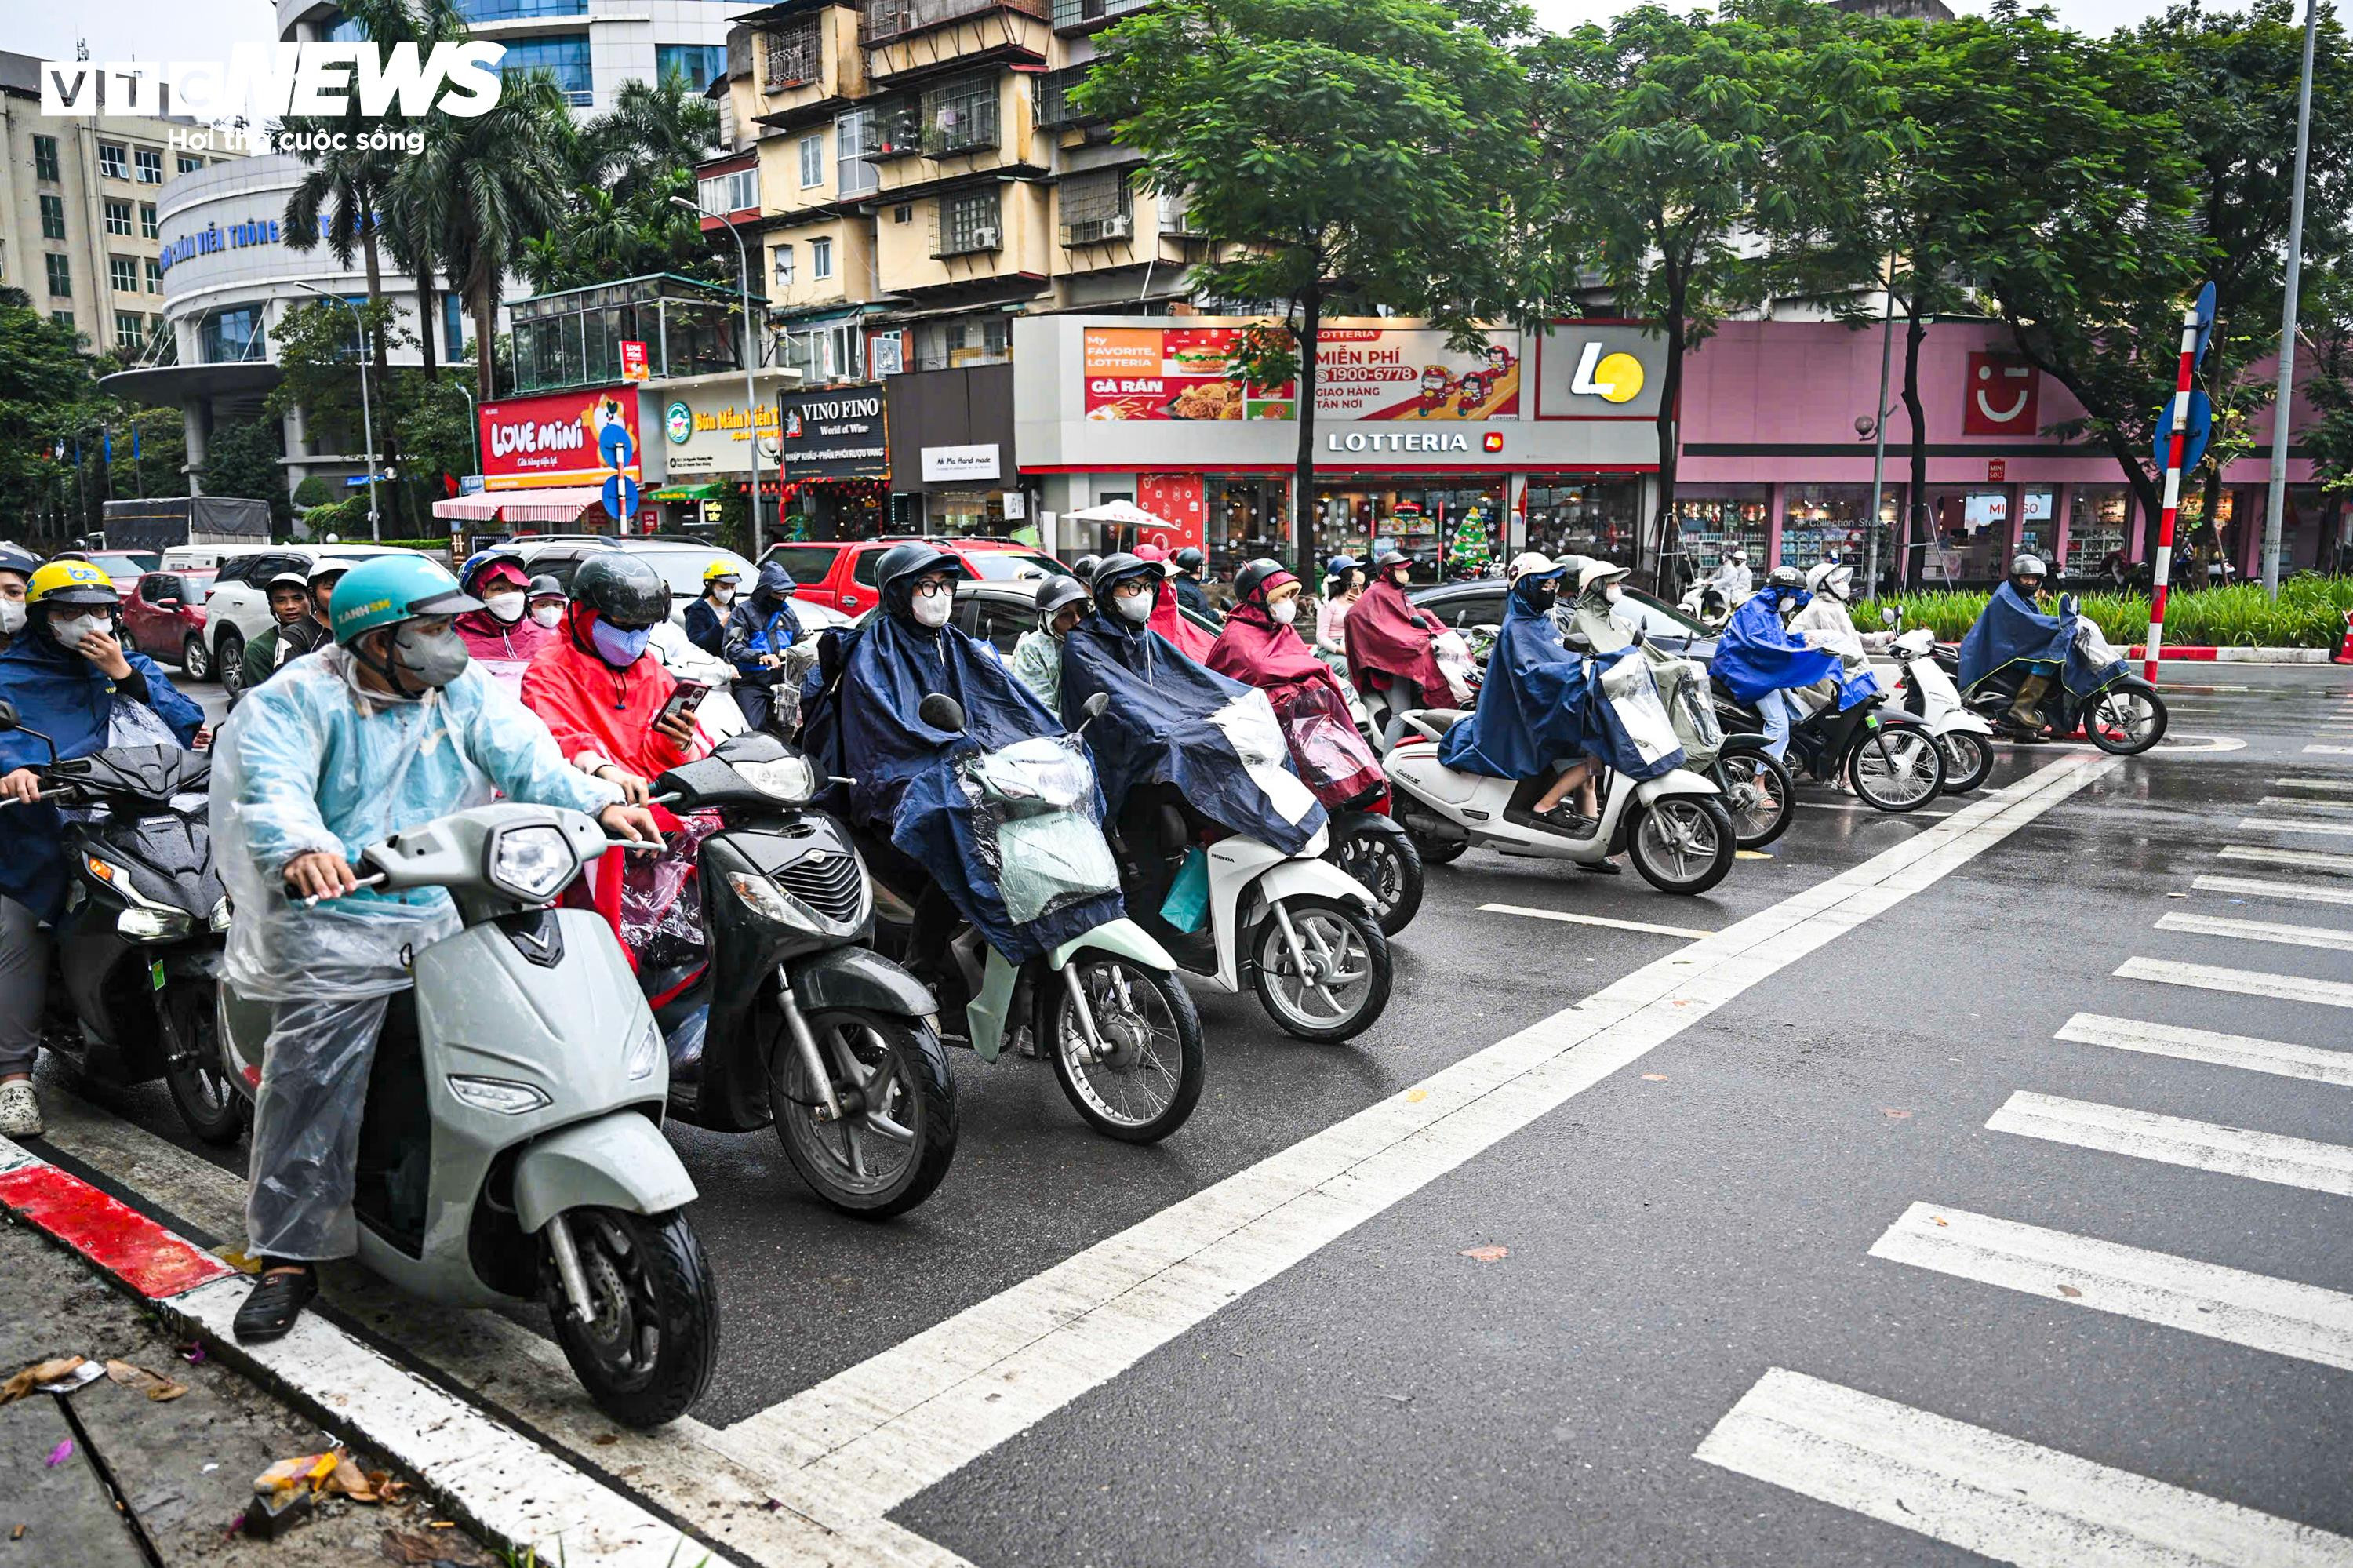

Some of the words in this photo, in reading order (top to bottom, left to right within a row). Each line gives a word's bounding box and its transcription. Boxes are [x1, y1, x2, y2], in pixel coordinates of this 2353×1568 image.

[227, 217, 280, 249] THÔNG
[1087, 336, 1107, 346] My
[1087, 347, 1155, 356] FAVORITE,
[1315, 344, 1362, 365] MIỄN
[1368, 347, 1400, 364] PHÍ
[1087, 358, 1151, 367] LOTTERIA
[1331, 366, 1413, 382] 1900-6778
[1091, 378, 1118, 393] GÀ
[1121, 378, 1163, 392] RÁN
[1315, 387, 1344, 397] GIAO
[1346, 384, 1380, 396] HÀNG
[802, 401, 839, 421] VINO
[842, 398, 878, 418] FINO
[1316, 398, 1339, 411] TẬN
[1342, 399, 1362, 409] NƠI
[694, 412, 716, 431] Bún
[718, 406, 744, 429] Mắm
[820, 424, 842, 435] World
[842, 424, 849, 434] of
[850, 424, 869, 433] Wine
[491, 421, 536, 458] LOVE
[1328, 433, 1469, 452] LOTTERIA
[867, 447, 885, 457] VANG
[1809, 518, 1855, 527] Collection
[67, 566, 99, 581] be
[143, 817, 176, 826] HONDA
[1211, 853, 1235, 863] HONDA
